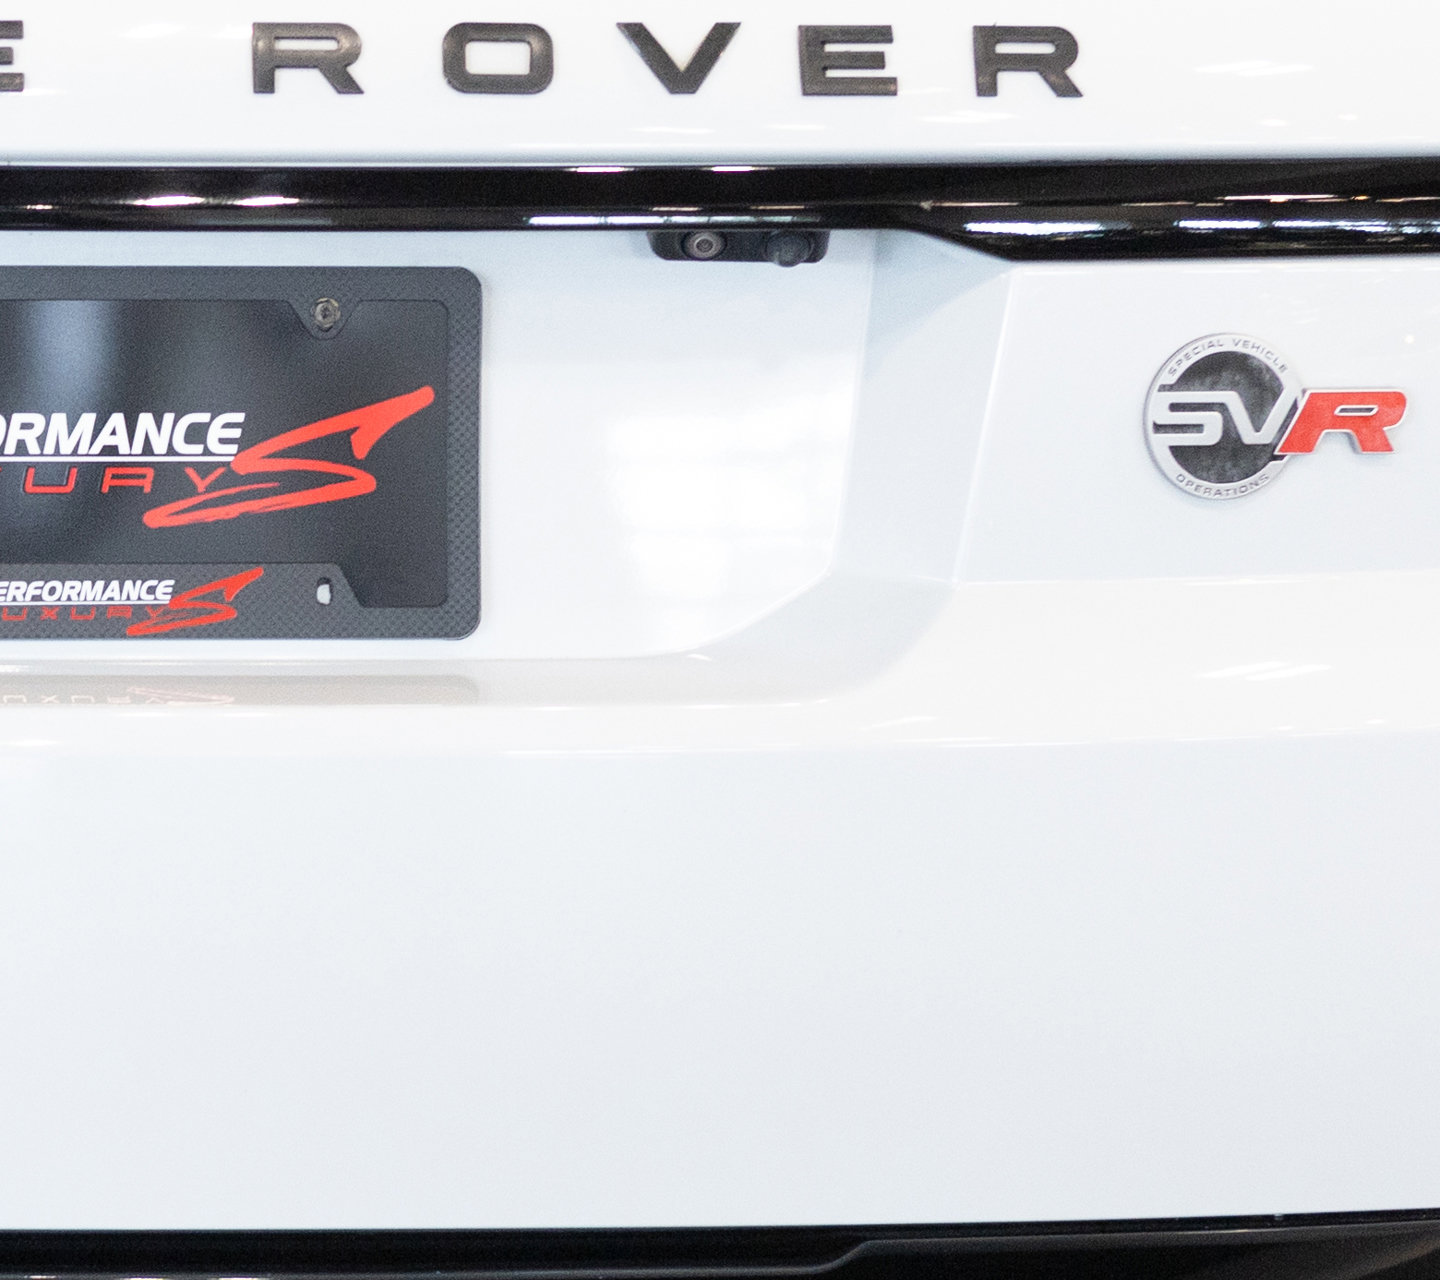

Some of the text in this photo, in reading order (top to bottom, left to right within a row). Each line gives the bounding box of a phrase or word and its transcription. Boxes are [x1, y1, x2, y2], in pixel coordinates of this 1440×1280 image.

[251, 21, 1084, 98] ROVER
[1167, 337, 1288, 377] SPECIAL VEHICLE
[1153, 388, 1408, 454] SVR
[1175, 473, 1271, 498] OPERATIONS
